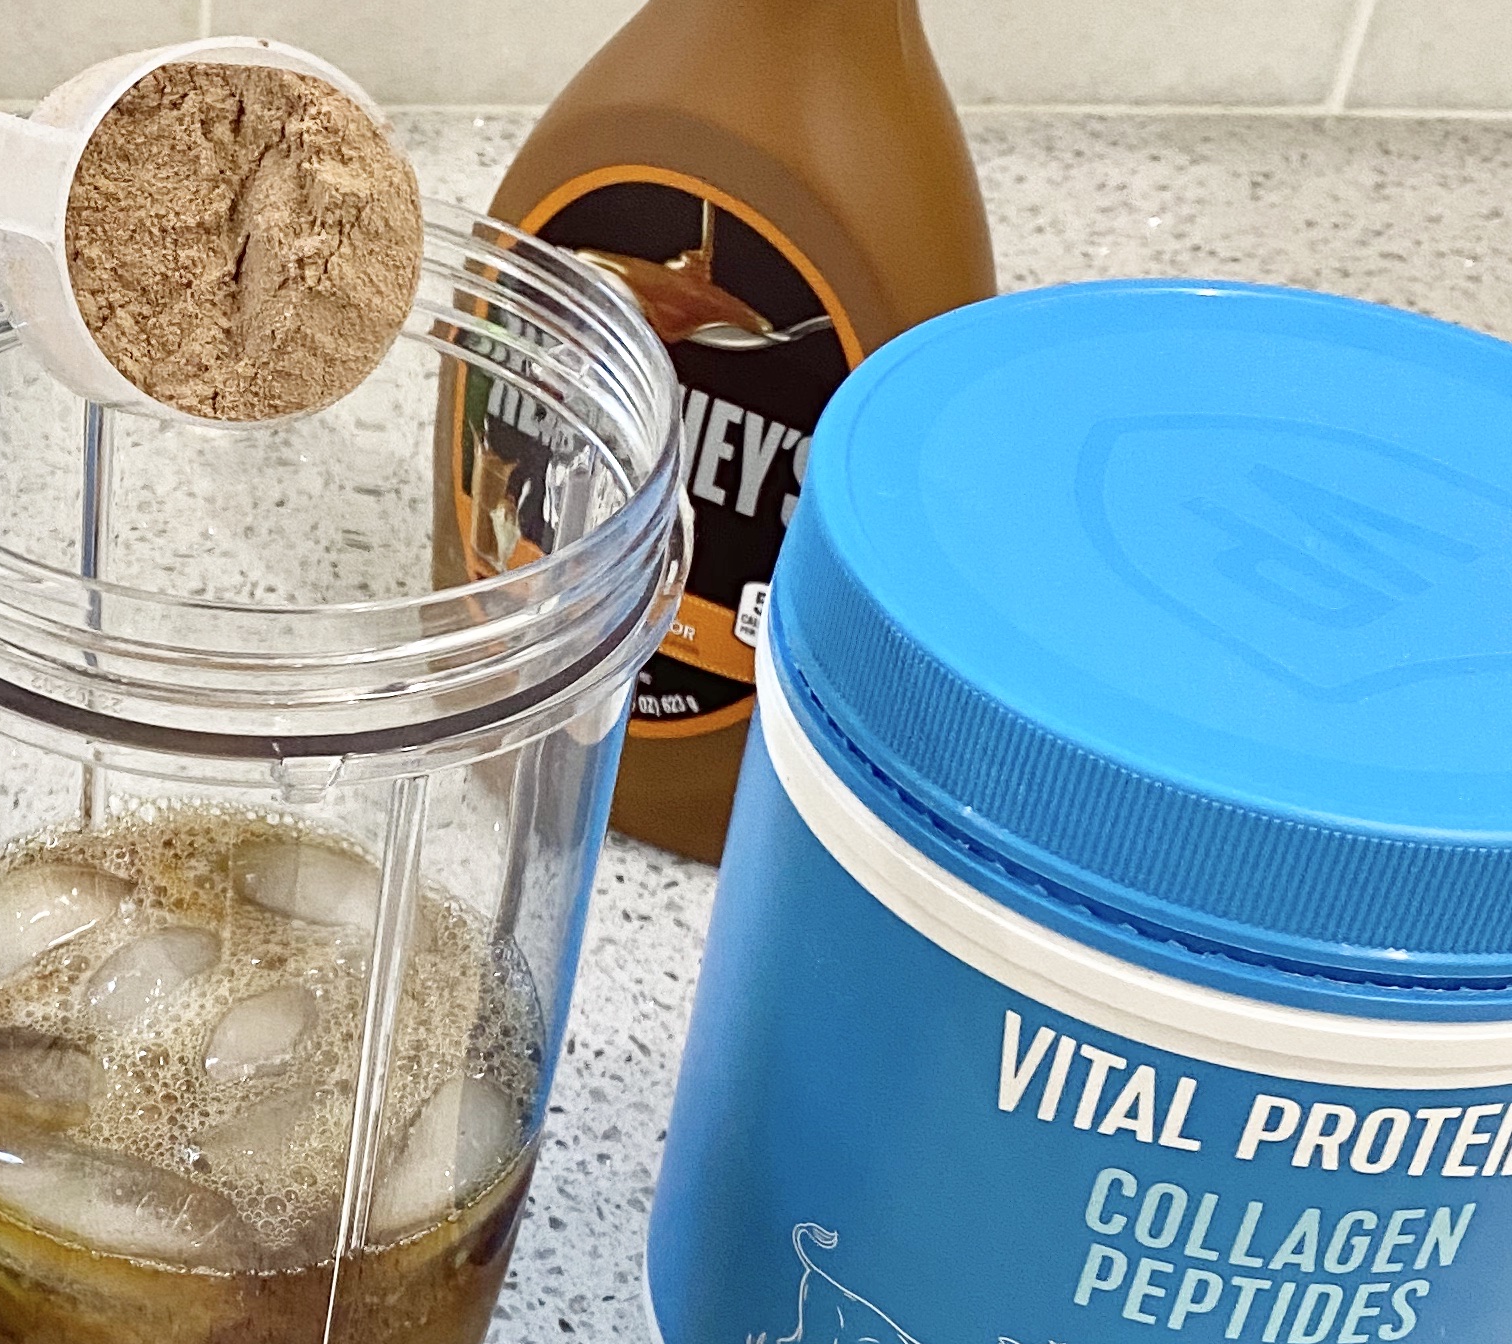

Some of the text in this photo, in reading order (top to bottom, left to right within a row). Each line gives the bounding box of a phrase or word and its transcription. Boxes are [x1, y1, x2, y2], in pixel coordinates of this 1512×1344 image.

[997, 1009, 1512, 1177] VITAL PROTEI
[1086, 1166, 1476, 1274] COLLAGEN
[1073, 1243, 1430, 1344] PEPTIDES
